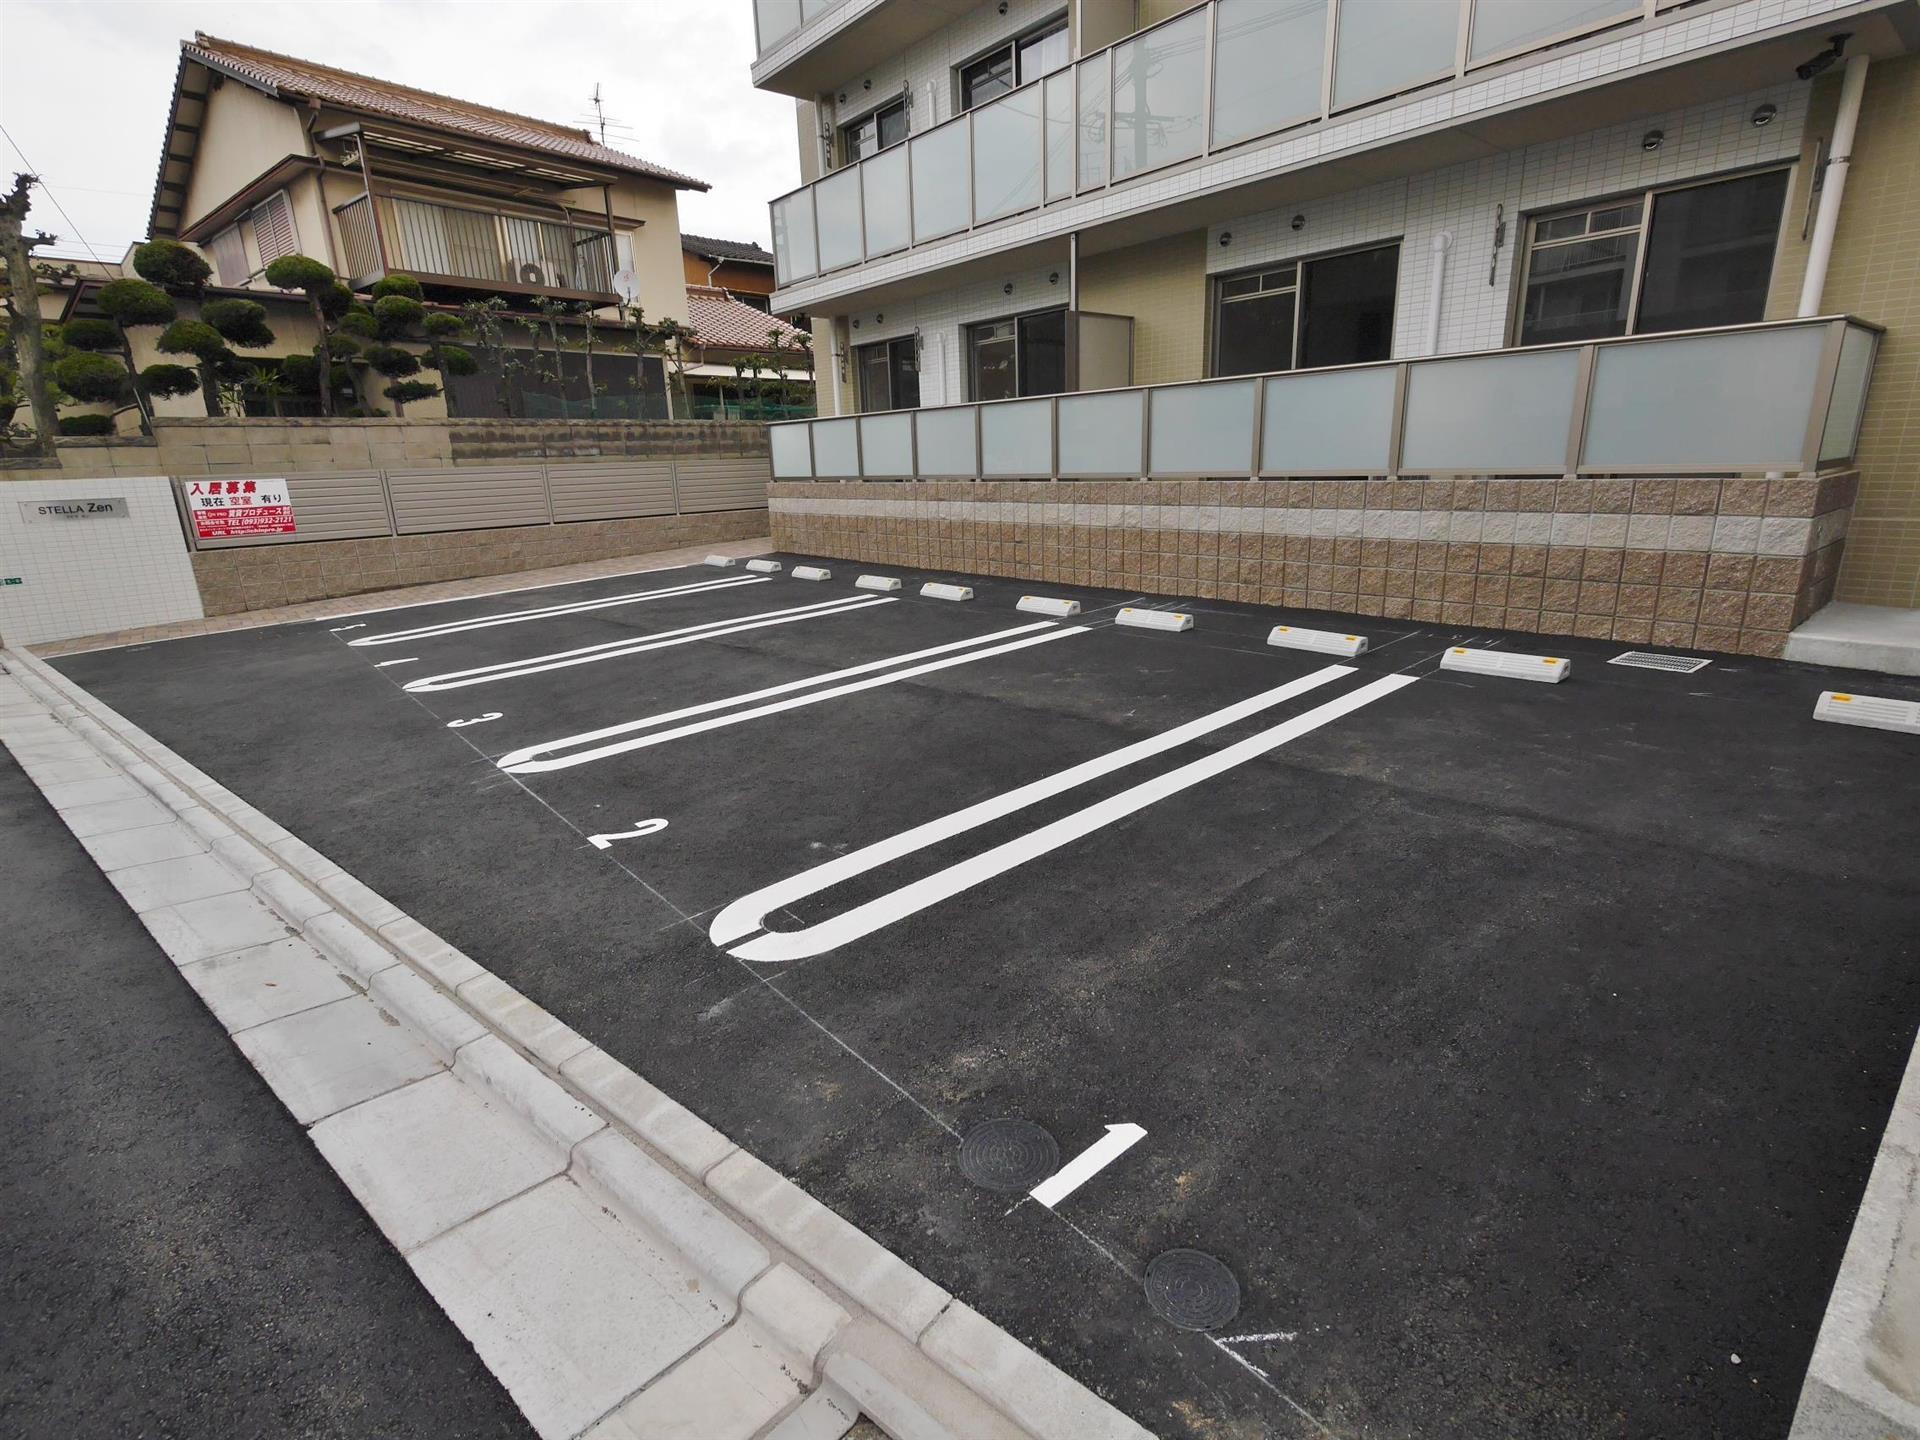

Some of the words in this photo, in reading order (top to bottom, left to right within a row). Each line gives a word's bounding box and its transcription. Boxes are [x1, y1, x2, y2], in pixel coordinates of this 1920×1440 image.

[190, 481, 256, 495] 入居募集
[201, 497, 225, 507] 現在
[229, 496, 253, 506] 空室
[261, 494, 282, 504] 有り
[38, 506, 84, 515] STELLA
[87, 502, 113, 513] Zen
[446, 712, 504, 728] 3
[586, 818, 669, 850] 2
[1029, 1122, 1148, 1208] 1
